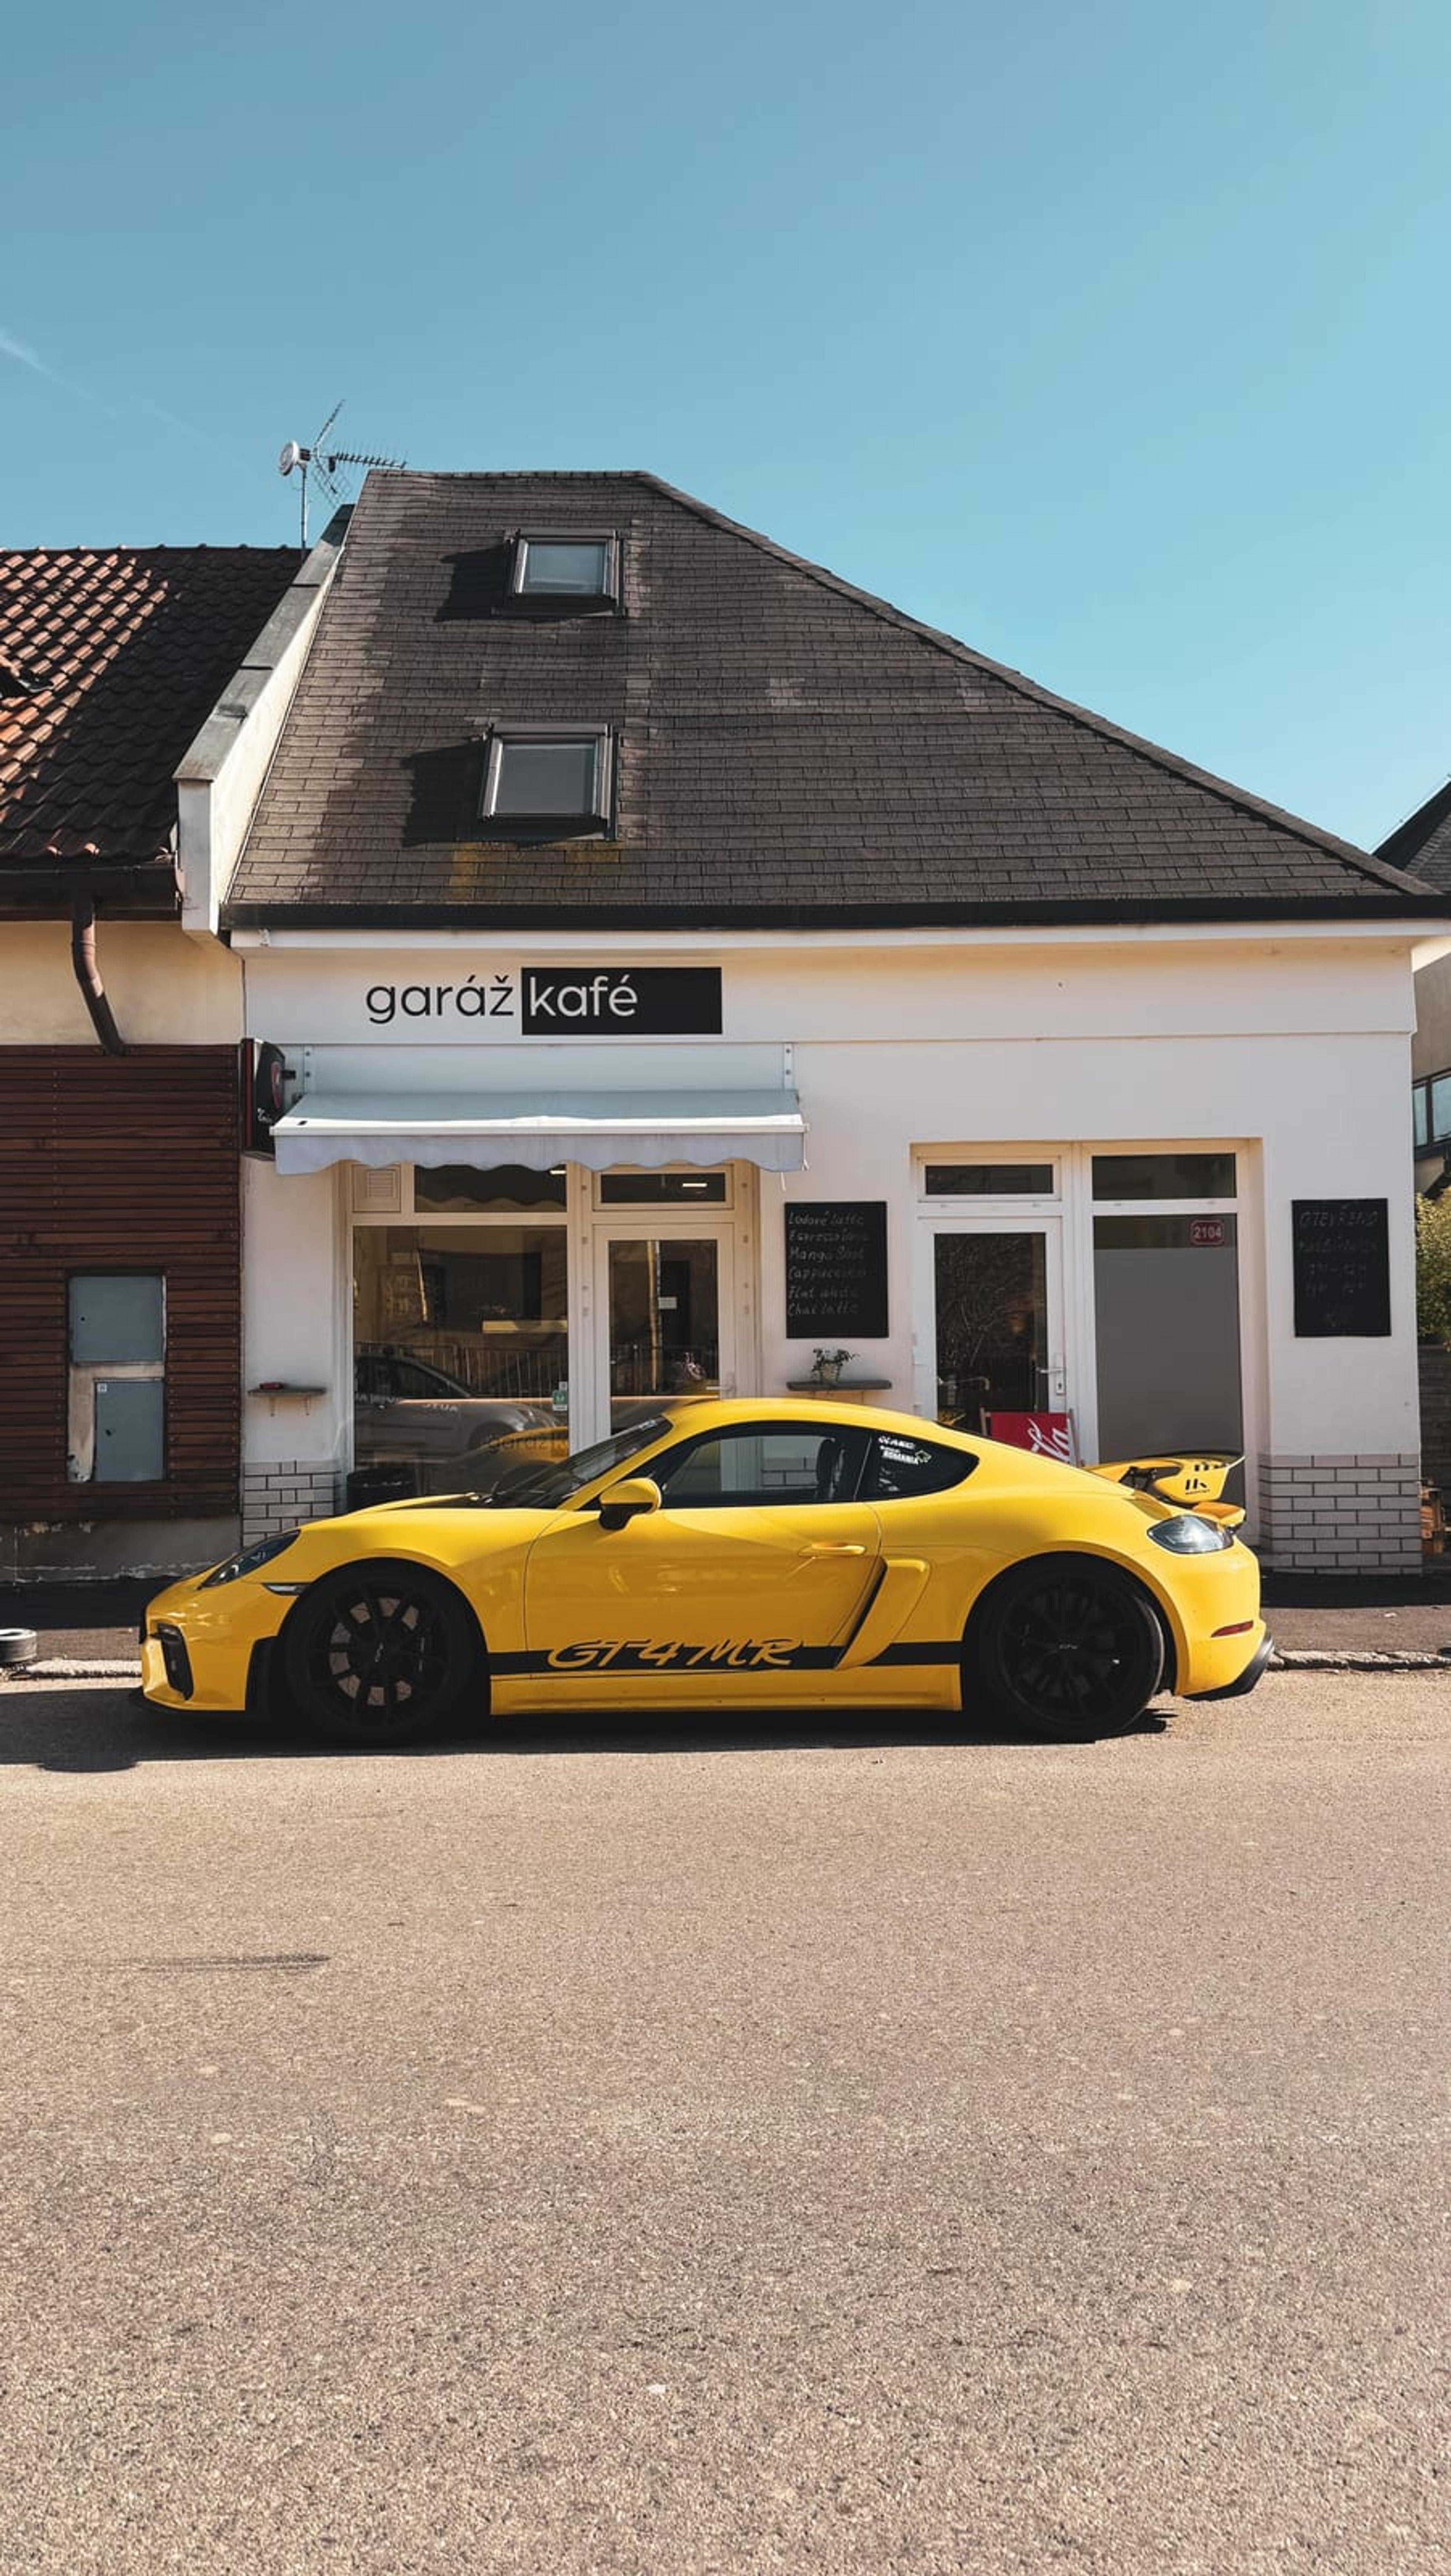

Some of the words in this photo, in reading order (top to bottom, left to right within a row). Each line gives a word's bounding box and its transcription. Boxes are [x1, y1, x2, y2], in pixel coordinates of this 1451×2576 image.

[366, 975, 514, 1024] garáž
[529, 974, 638, 1017] kafé
[1194, 1226, 1221, 1239] 2104
